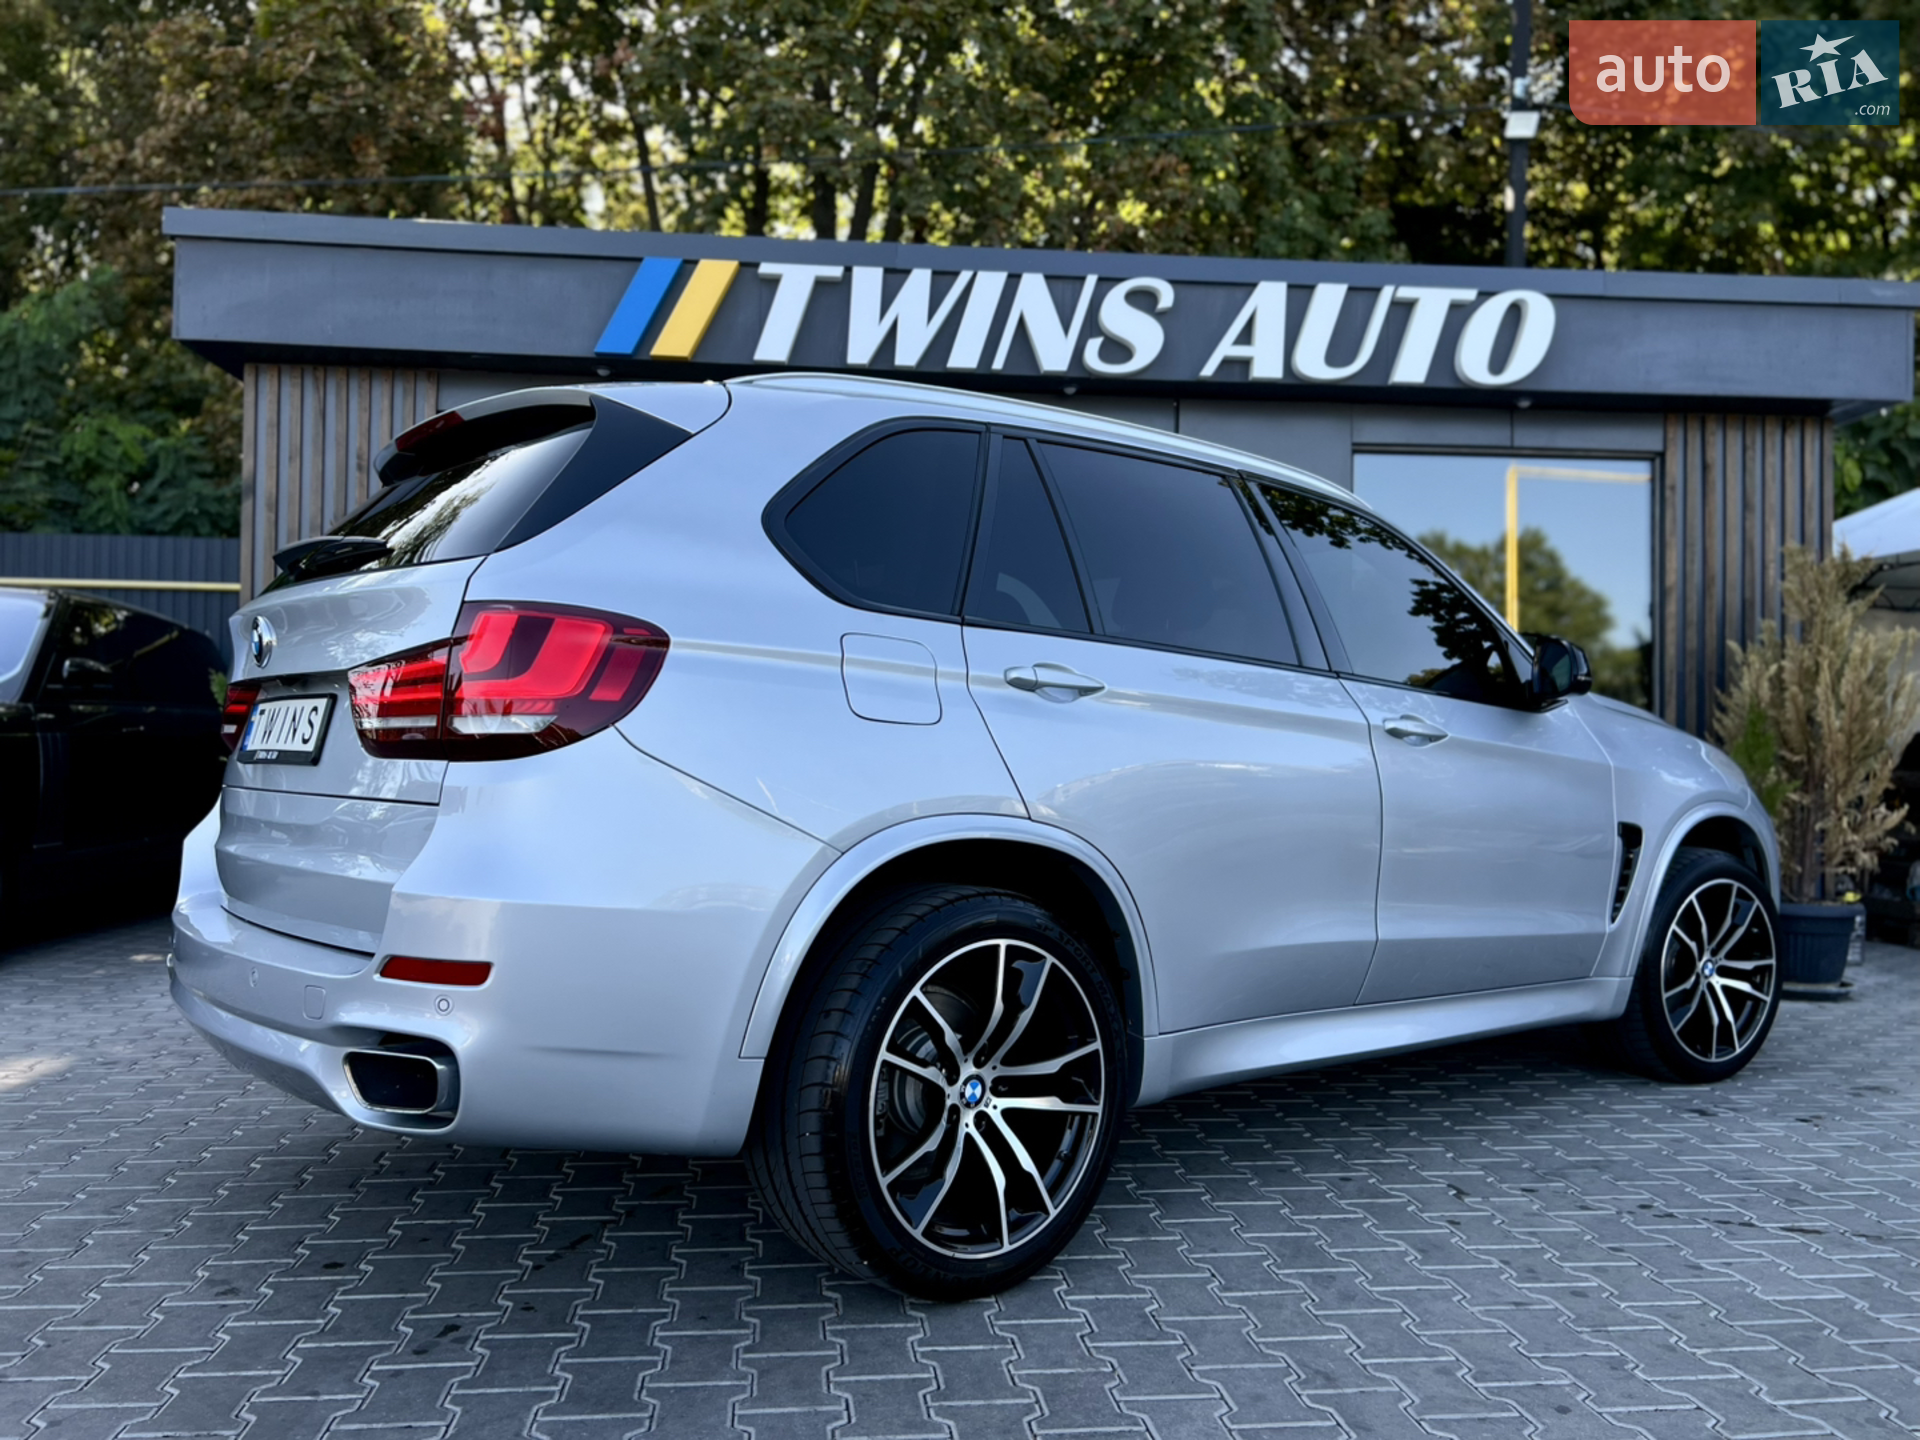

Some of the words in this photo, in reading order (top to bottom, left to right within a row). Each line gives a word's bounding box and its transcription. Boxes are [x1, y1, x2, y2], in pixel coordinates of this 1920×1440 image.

[754, 262, 1175, 376] TWINS
[1200, 281, 1557, 386] AUTO
[252, 706, 319, 745] TWINS
